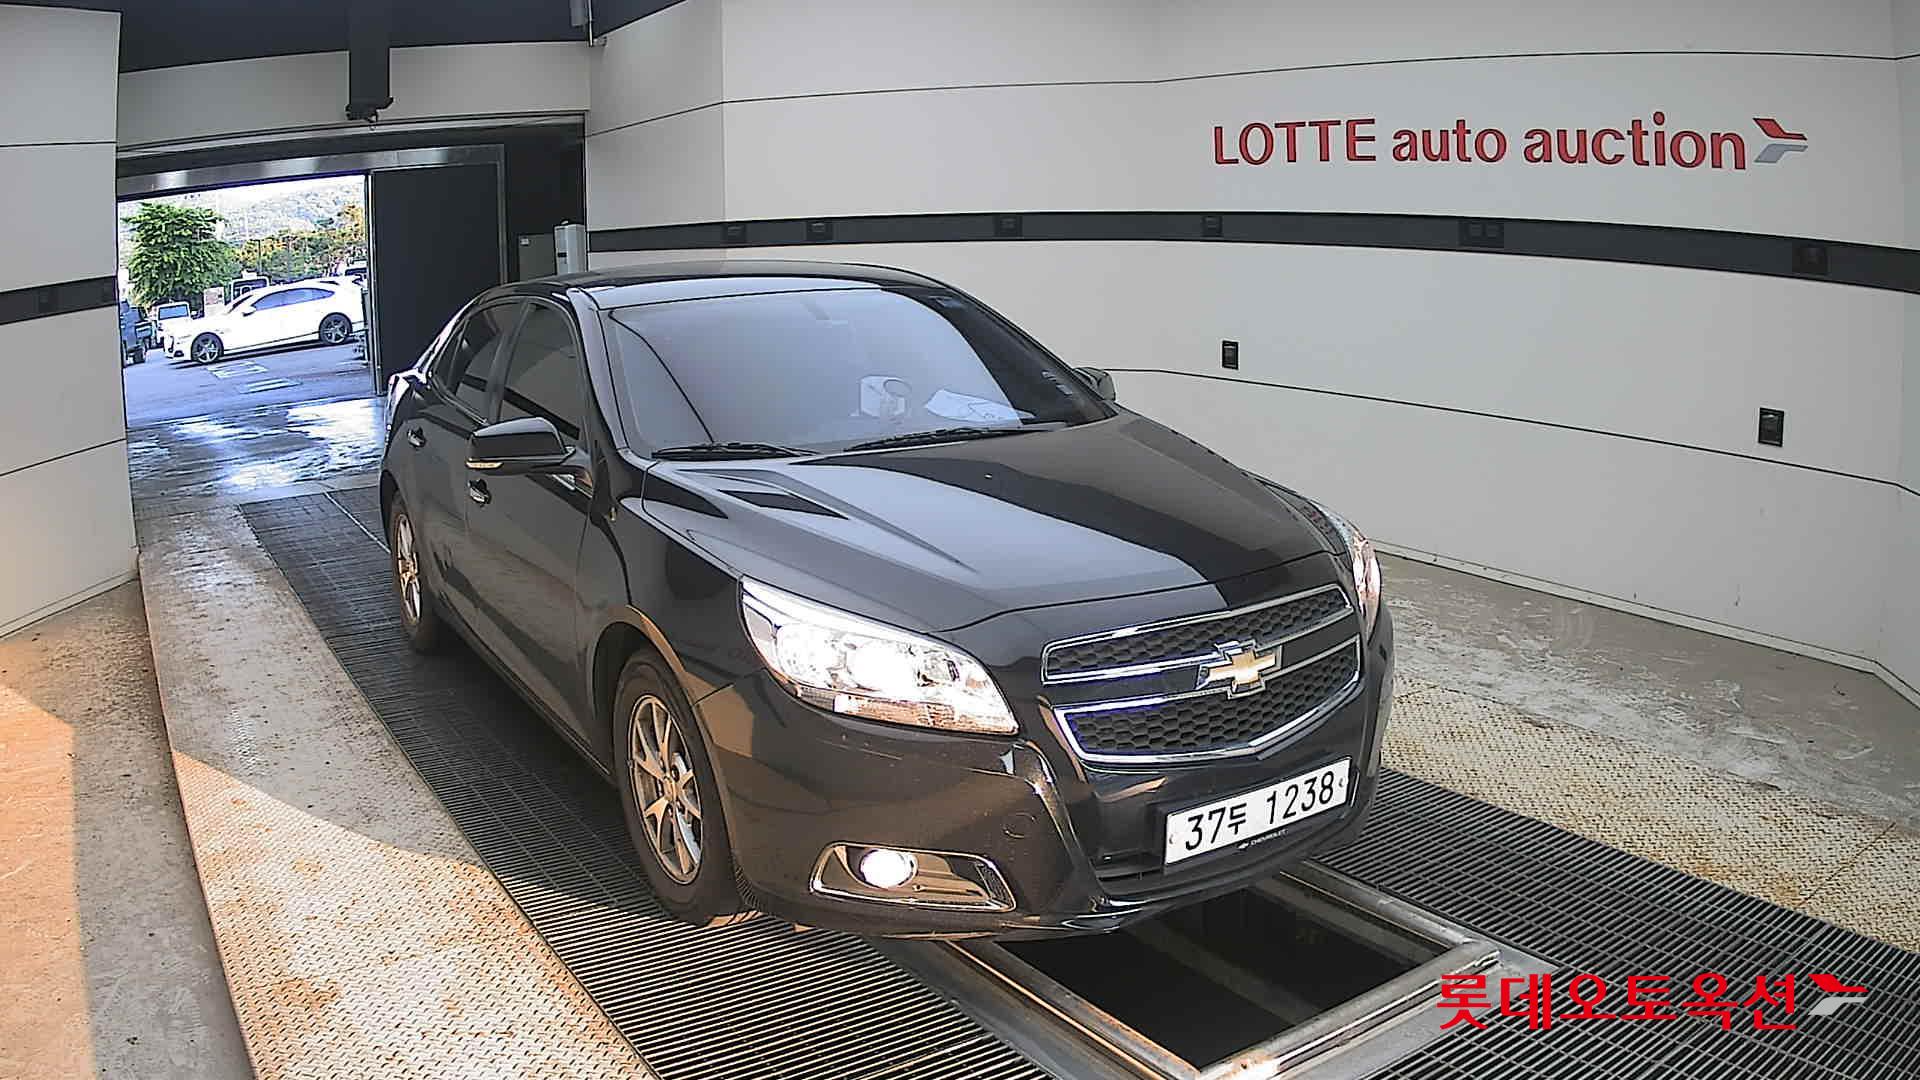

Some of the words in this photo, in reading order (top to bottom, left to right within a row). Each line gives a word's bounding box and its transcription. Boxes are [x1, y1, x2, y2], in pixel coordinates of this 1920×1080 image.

[1213, 118, 1377, 165] LOTTE
[1392, 119, 1507, 162] auto
[1523, 111, 1747, 170] auction
[1185, 803, 1248, 851] 37두
[1266, 770, 1335, 825] 1238
